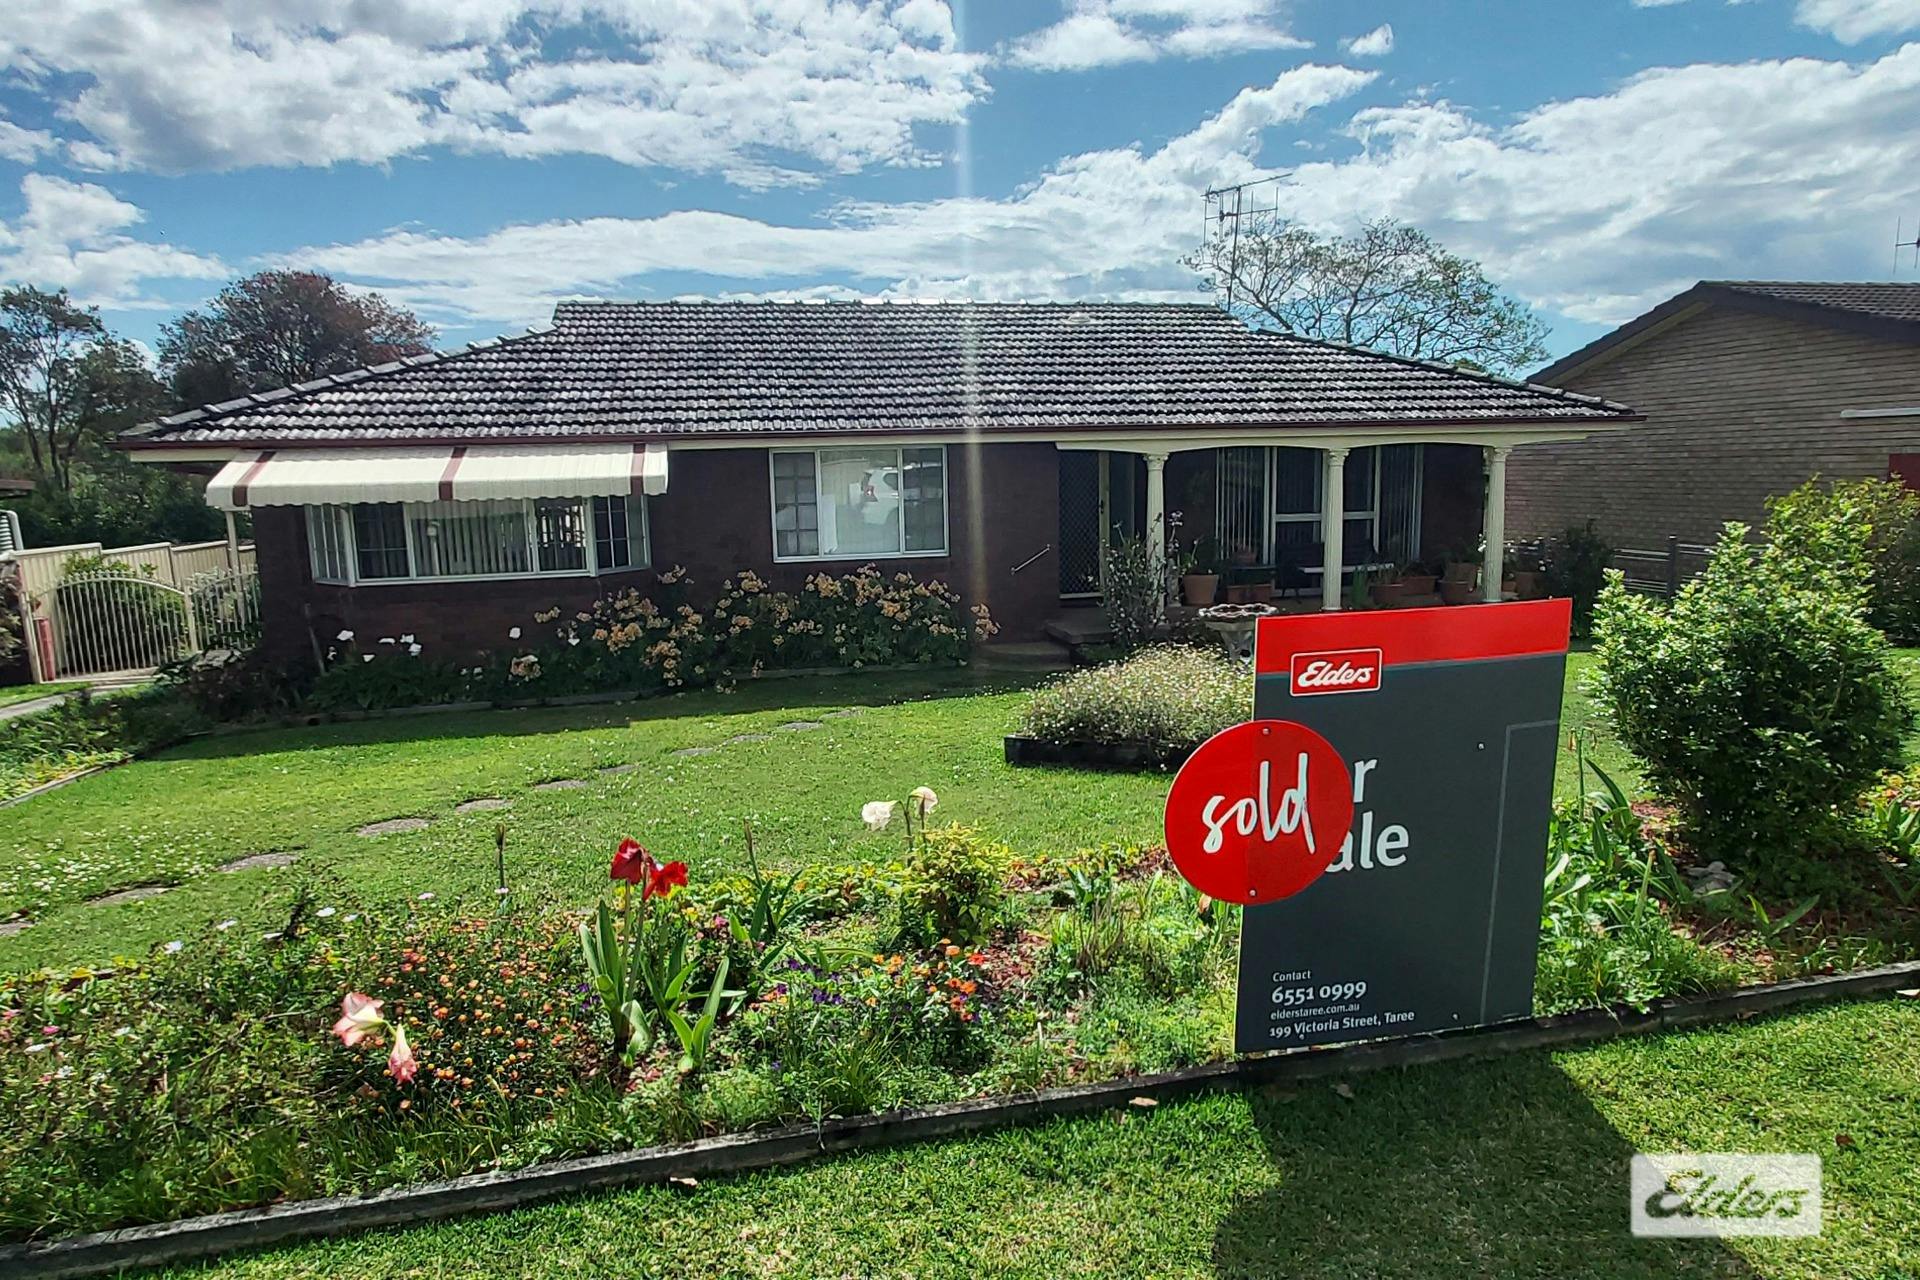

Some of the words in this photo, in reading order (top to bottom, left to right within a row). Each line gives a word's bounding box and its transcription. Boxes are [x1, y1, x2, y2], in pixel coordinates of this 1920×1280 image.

[1298, 660, 1374, 687] Elders
[1202, 752, 1315, 854] sold
[1325, 811, 1409, 873] ale
[1272, 970, 1312, 982] Contact
[1271, 985, 1315, 1006] 6551
[1319, 981, 1367, 1000] 0999
[1269, 1024, 1291, 1039] 199
[1294, 1019, 1340, 1034] Victoria
[1342, 1014, 1381, 1029] Street,
[1384, 1011, 1415, 1024] Taree
[1270, 1003, 1360, 1020] elderstaree.com.au
